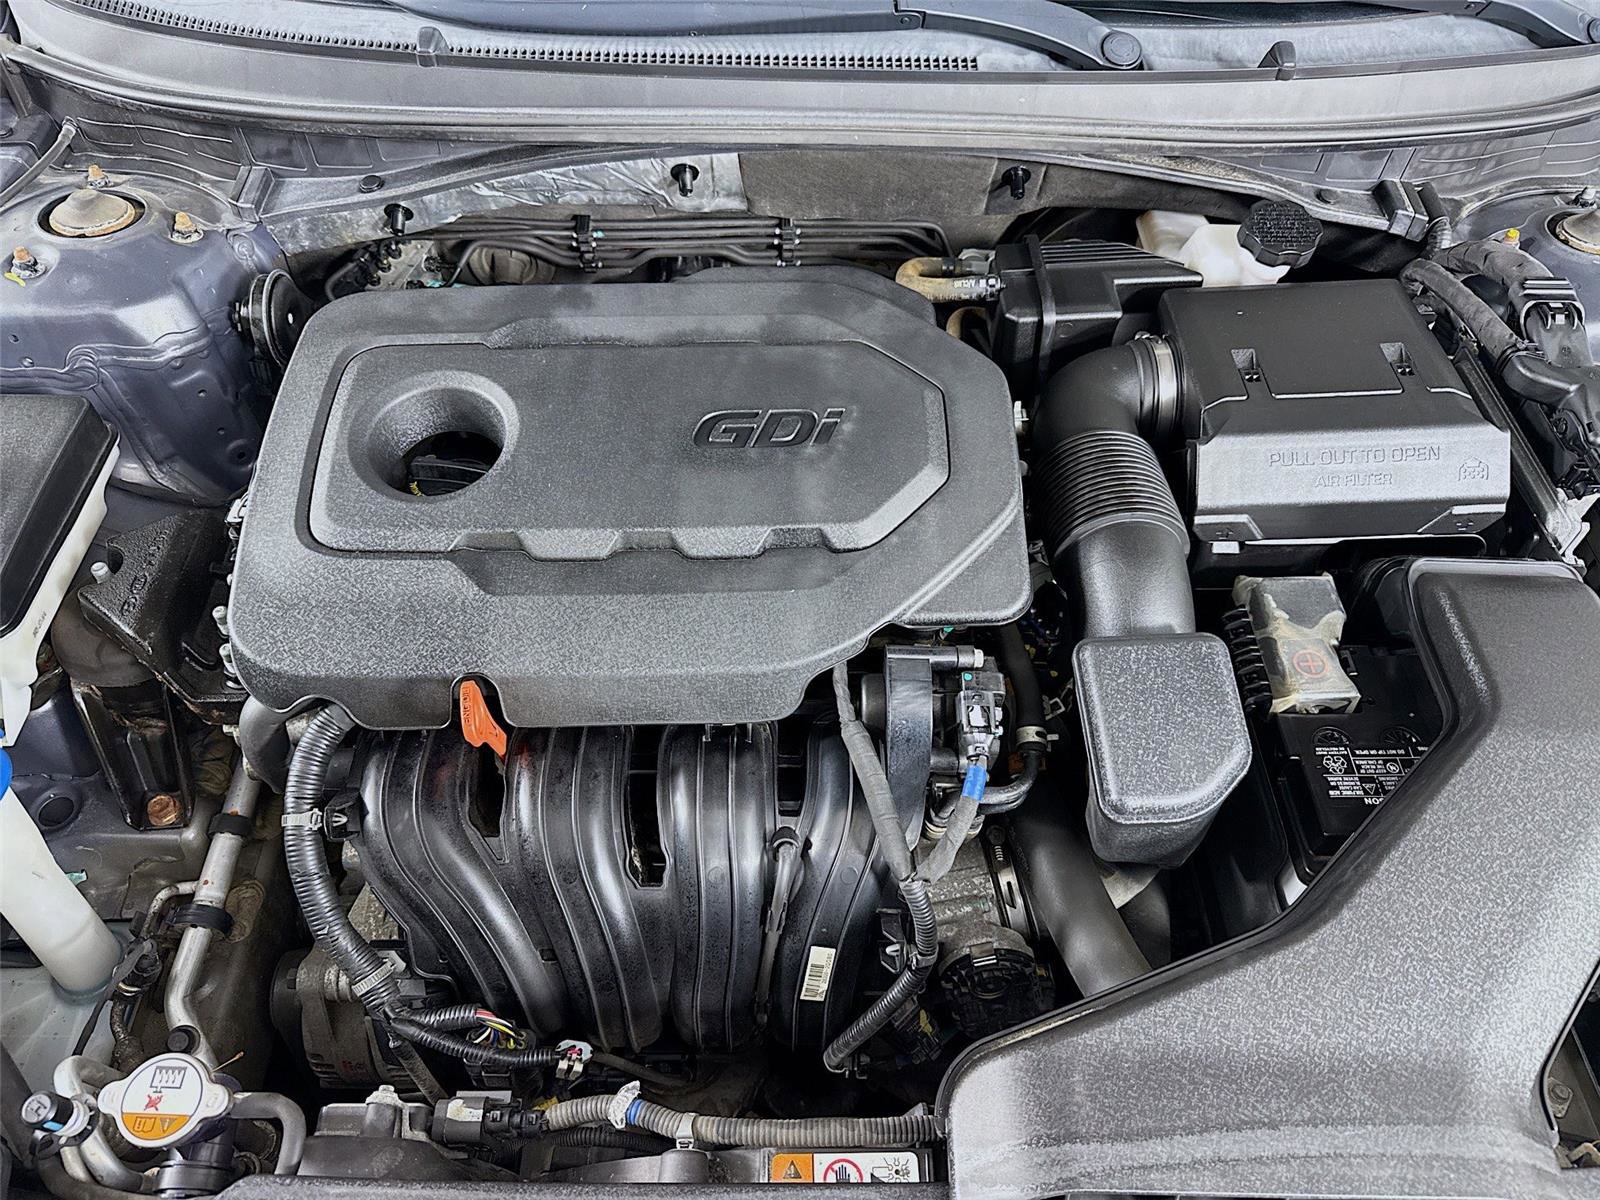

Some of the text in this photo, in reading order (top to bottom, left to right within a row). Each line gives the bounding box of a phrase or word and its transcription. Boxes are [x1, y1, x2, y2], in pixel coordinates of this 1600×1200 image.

[691, 408, 846, 448] GDi
[1269, 445, 1440, 467] PULL OUT TO OPEN
[1314, 472, 1393, 488] AIR FILTER
